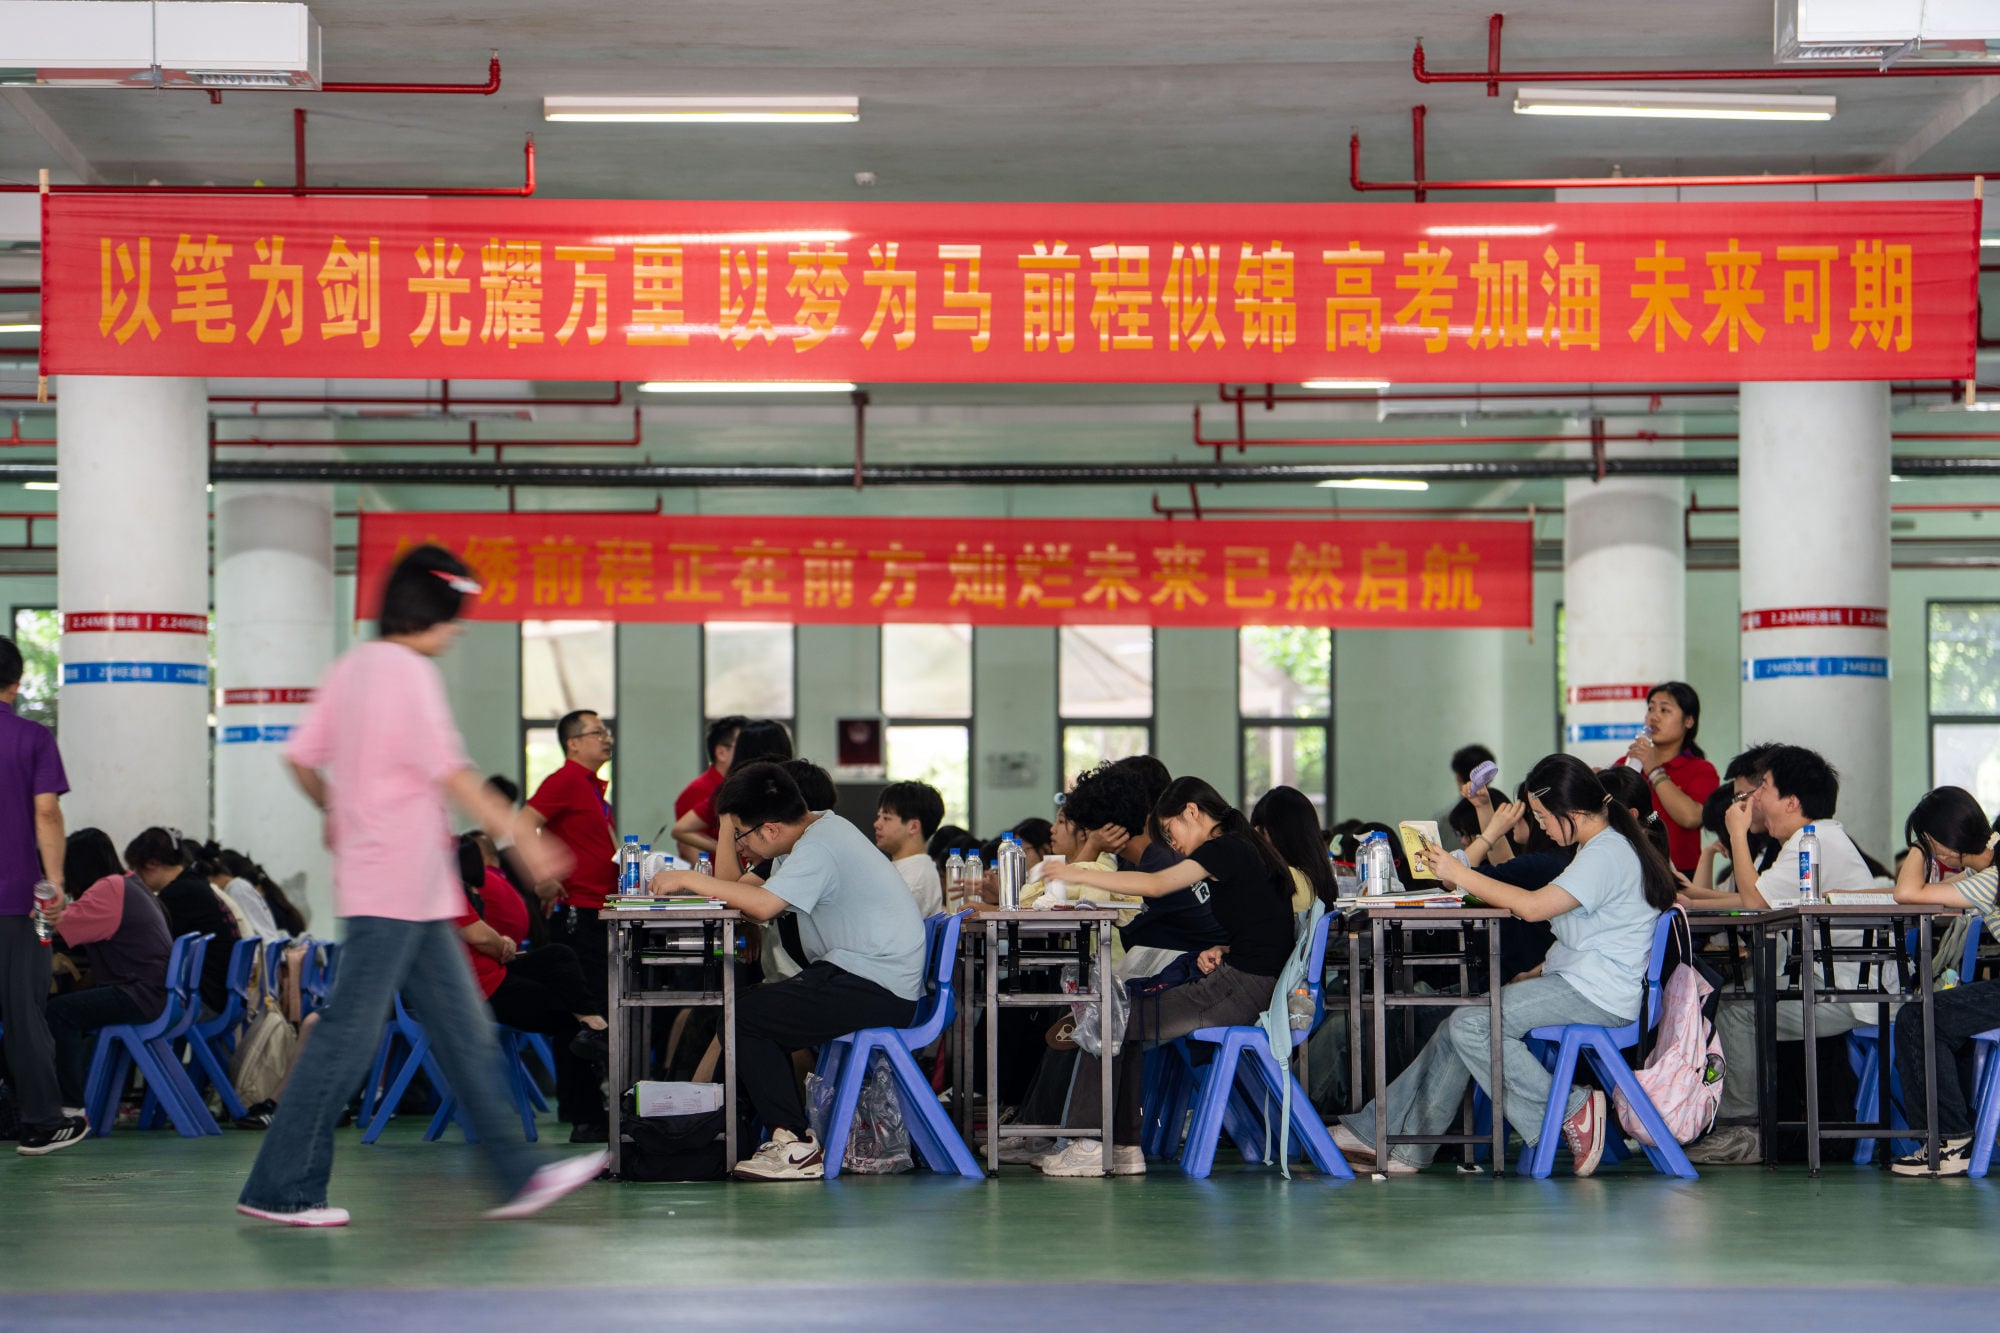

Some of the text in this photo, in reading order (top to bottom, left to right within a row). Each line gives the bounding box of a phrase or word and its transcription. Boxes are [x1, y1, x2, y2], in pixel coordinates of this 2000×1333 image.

[98, 232, 1913, 354] 以笔为剑 光耀万里 以梦为马 前程似锦 高考加油 未来可期
[393, 534, 1483, 612] 绣前程正在前方 灿烂未来已然启航
